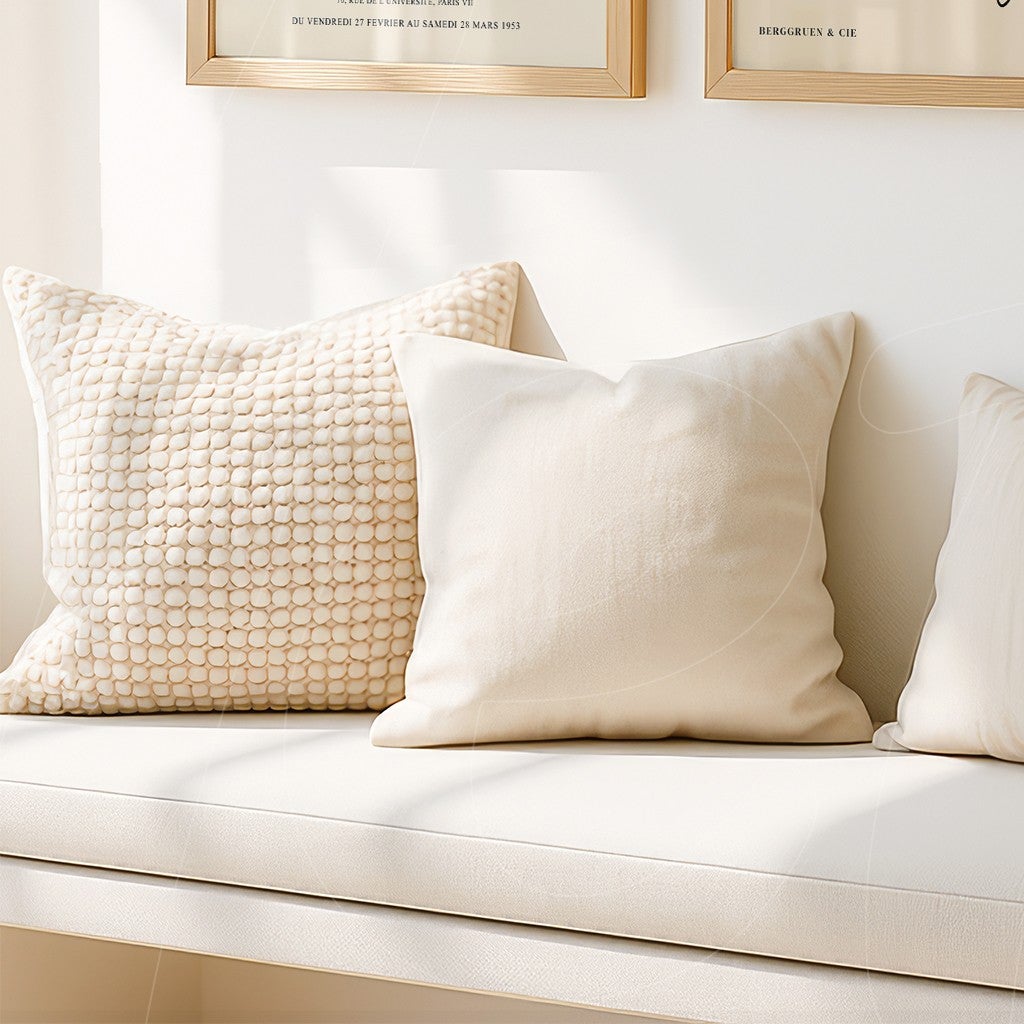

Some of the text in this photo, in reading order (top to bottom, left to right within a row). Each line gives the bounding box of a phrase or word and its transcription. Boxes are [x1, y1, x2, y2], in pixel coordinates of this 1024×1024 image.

[291, 16, 521, 30] DU VENDREDI 27 FEVRIER AU SAMEDI 28 MARS 1953
[758, 26, 857, 38] BERGGRUEN & CIE
